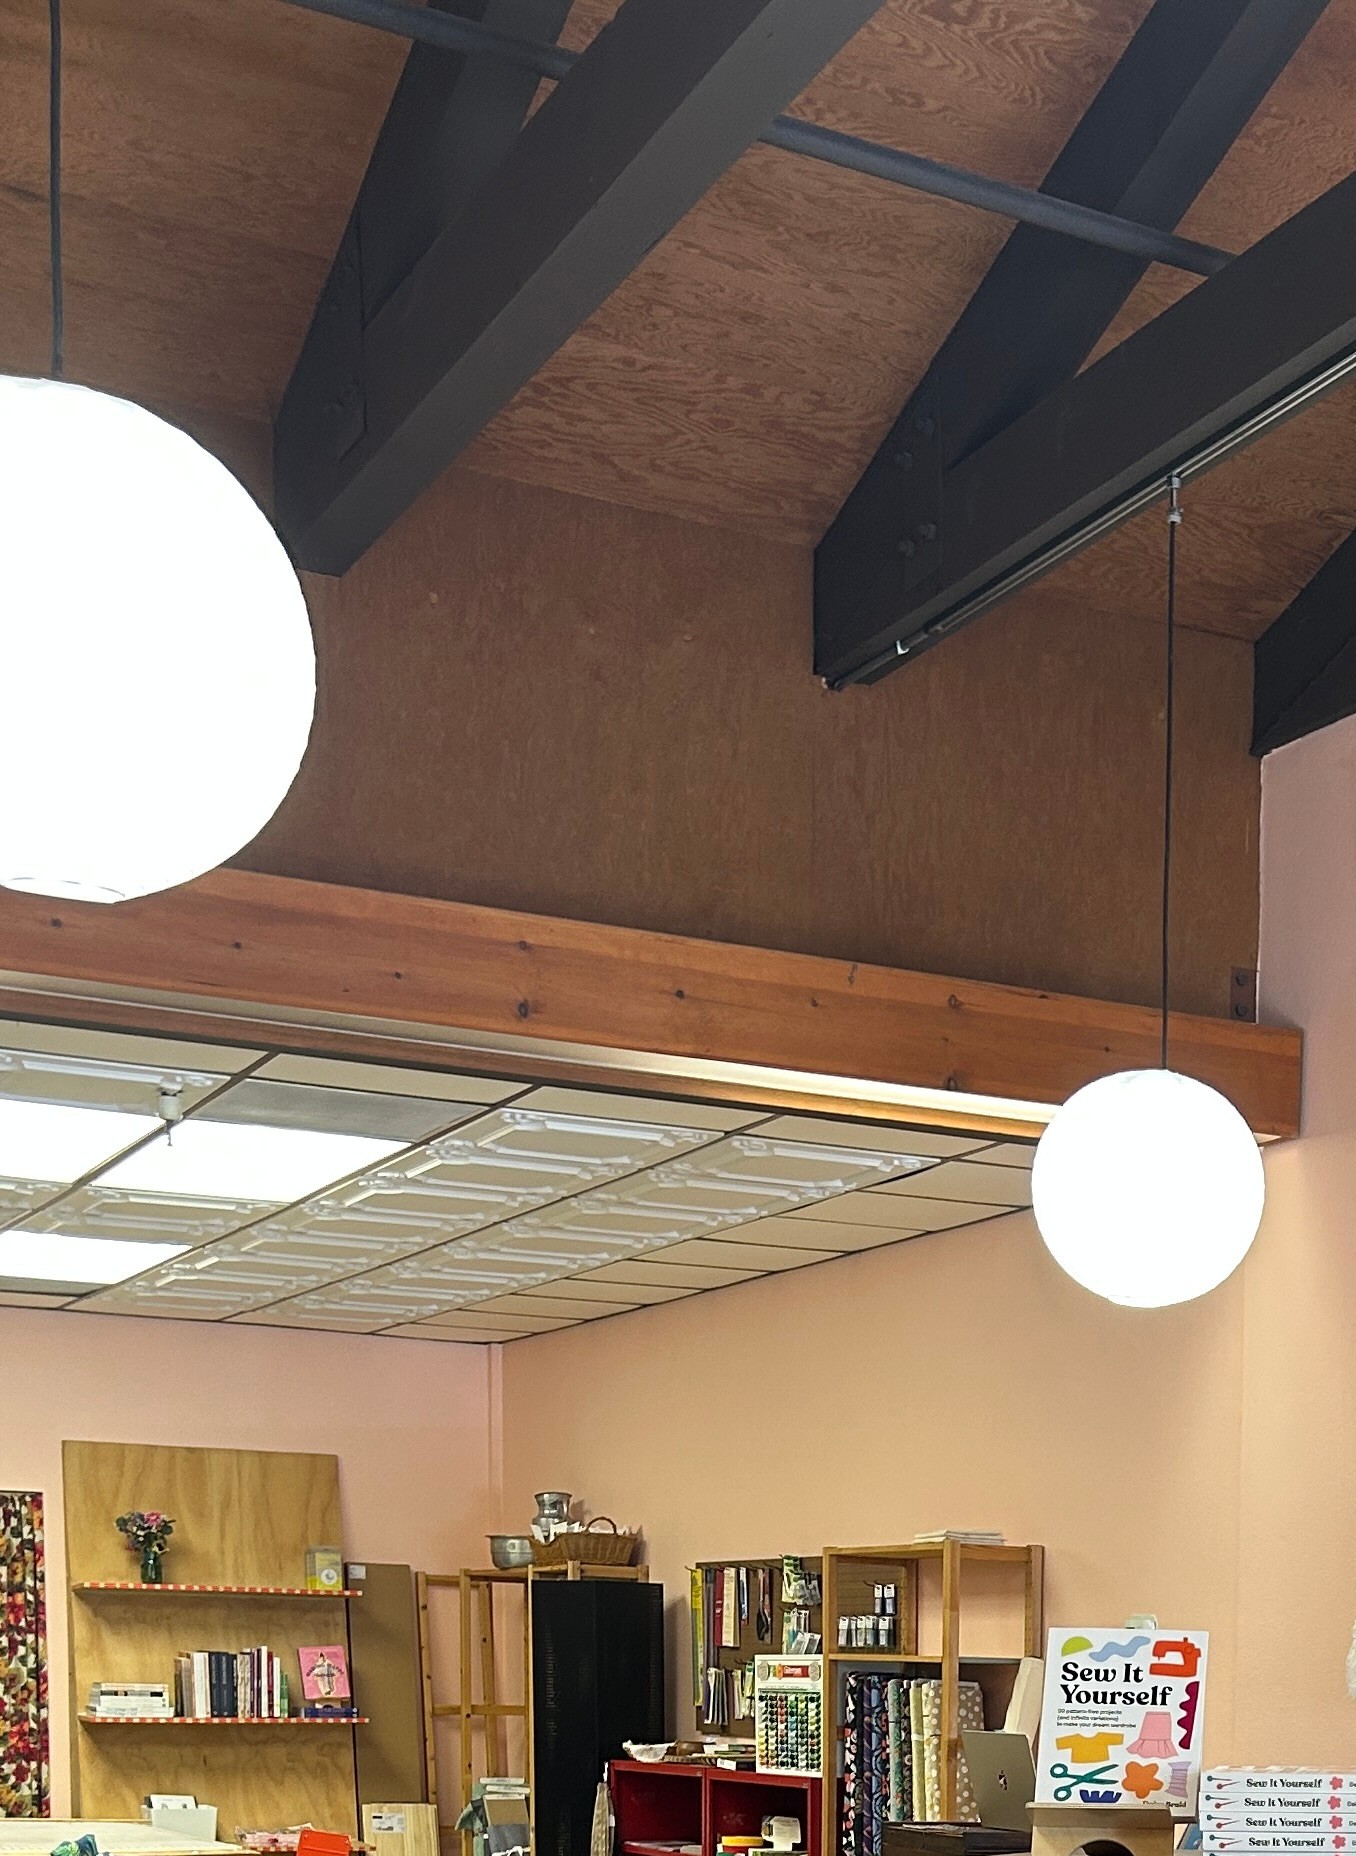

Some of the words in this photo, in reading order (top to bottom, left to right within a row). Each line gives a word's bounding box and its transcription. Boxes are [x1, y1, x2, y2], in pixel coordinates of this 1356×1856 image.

[1061, 1661, 1117, 1682] Sew
[1123, 1663, 1144, 1683] It
[1060, 1684, 1173, 1706] Yourself
[1246, 1778, 1268, 1788] Sew
[1270, 1779, 1278, 1788] It
[1280, 1779, 1323, 1788] Yourself
[1244, 1797, 1266, 1807] Sew
[1268, 1798, 1276, 1807] It
[1278, 1798, 1321, 1807] Yourself
[1246, 1817, 1267, 1826] Sew
[1269, 1817, 1277, 1826] It
[1279, 1817, 1322, 1827] Yourself
[1248, 1837, 1270, 1846] Sew
[1272, 1837, 1280, 1846] It
[1282, 1837, 1325, 1847] Yourself
